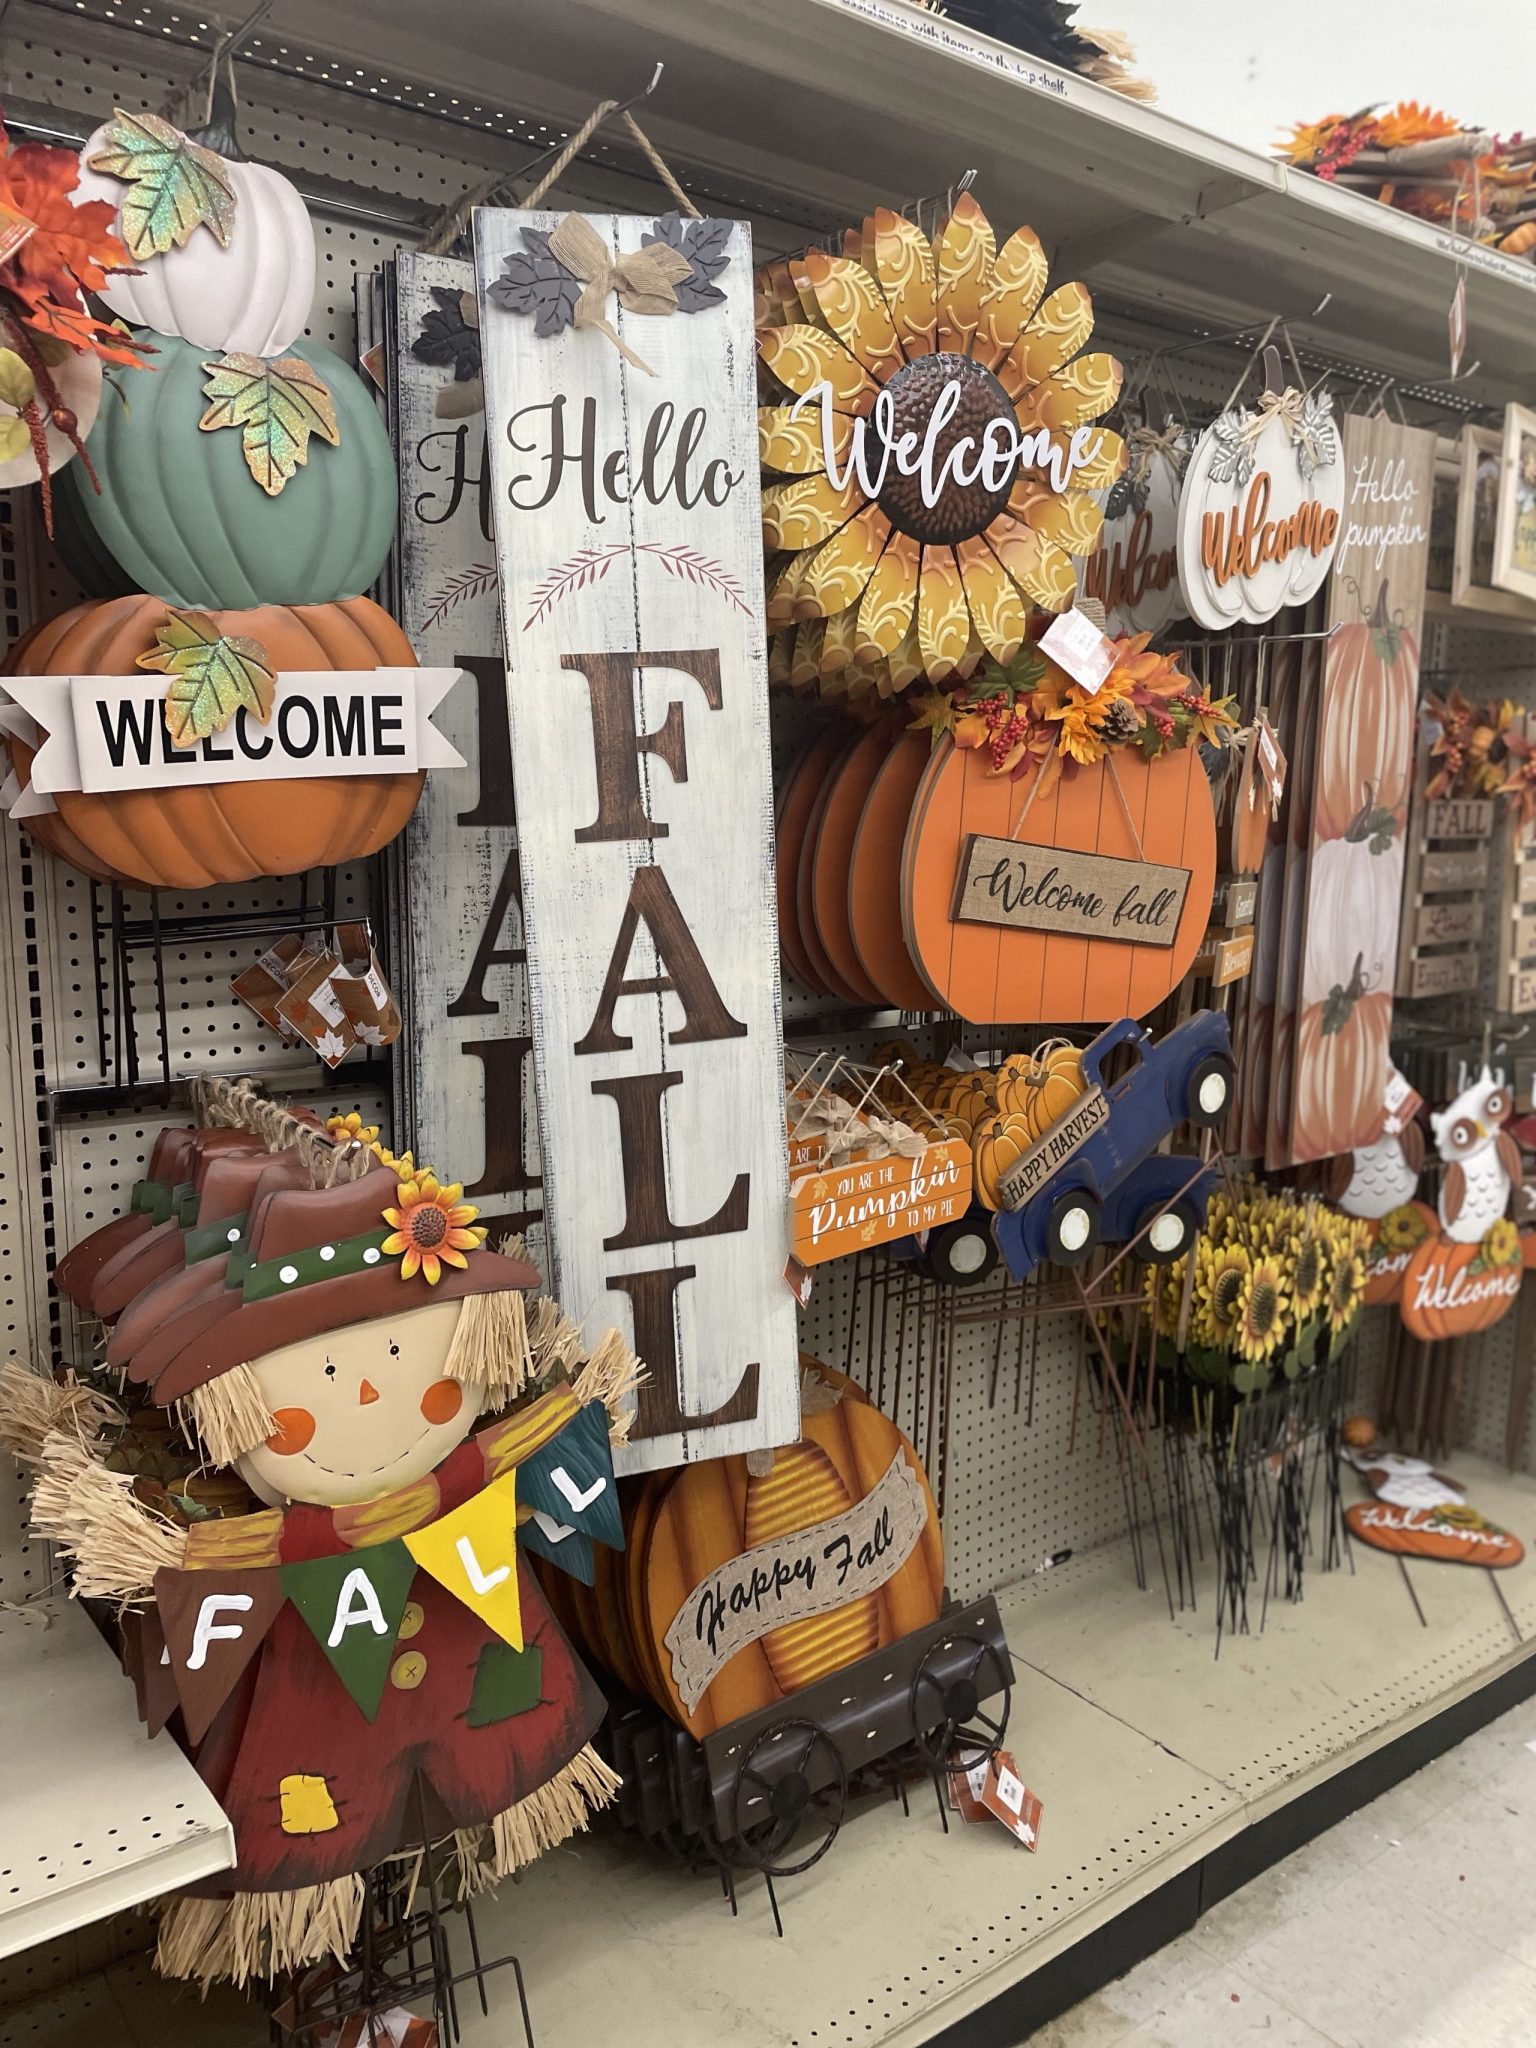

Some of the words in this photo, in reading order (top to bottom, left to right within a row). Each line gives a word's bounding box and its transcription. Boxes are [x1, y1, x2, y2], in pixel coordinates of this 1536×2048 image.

[911, 22, 939, 39] with
[508, 394, 745, 524] Hello
[790, 380, 1103, 508] Welcome
[1353, 456, 1419, 504] Hello
[1202, 471, 1339, 586] Welcome
[1335, 505, 1427, 575] pumpkin
[1434, 804, 1486, 835] FALL
[973, 858, 1106, 917] Welcome
[1113, 885, 1178, 927] fall
[261, 958, 285, 980] DECOR
[368, 974, 381, 998] DECOR
[560, 648, 760, 1440] FALL
[837, 1178, 854, 1196] YOU
[858, 1172, 874, 1189] ARE
[879, 1166, 895, 1185] THE
[1007, 1151, 1053, 1204] HAPPY
[1047, 1095, 1108, 1165] HARVEST
[809, 1156, 960, 1245] Pumpkin
[907, 1211, 919, 1228] TO
[922, 1205, 937, 1223] MY
[940, 1199, 954, 1217] PIE
[1413, 1263, 1520, 1311] Welcome
[696, 1555, 817, 1655] Happy
[824, 1506, 894, 1587] Fall
